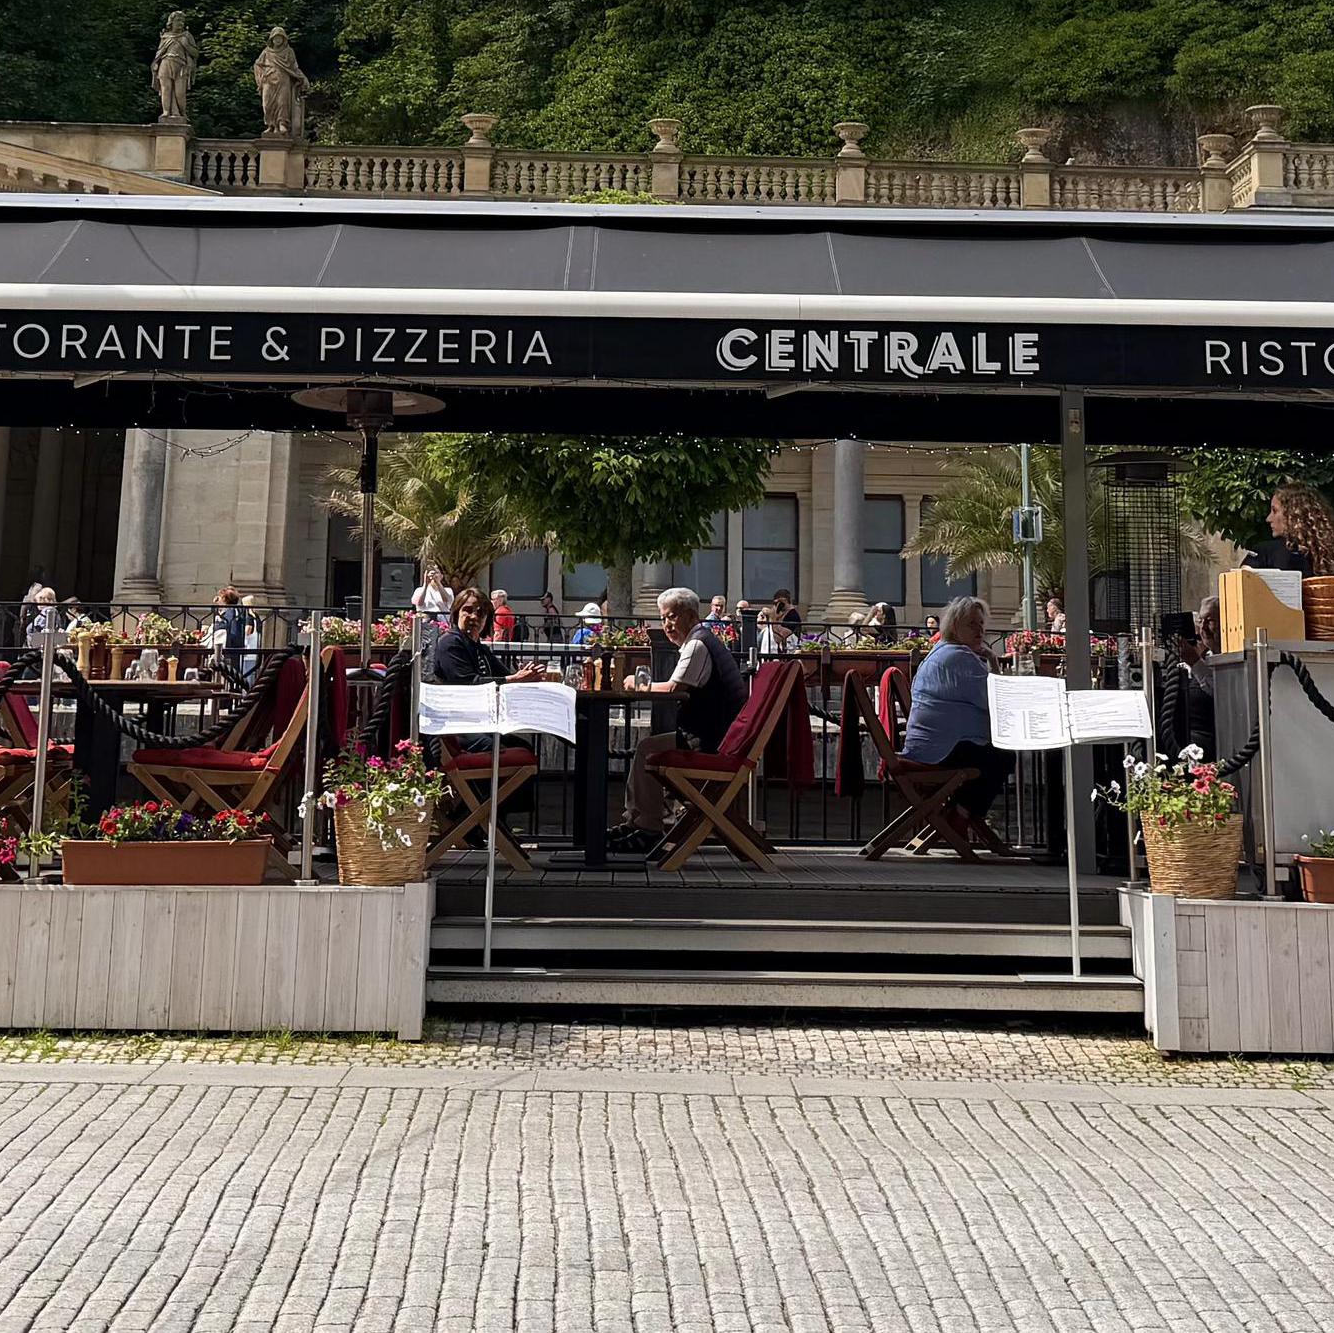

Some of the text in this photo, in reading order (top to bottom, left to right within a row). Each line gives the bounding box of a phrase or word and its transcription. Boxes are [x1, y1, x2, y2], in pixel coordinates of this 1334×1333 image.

[261, 326, 291, 361] &
[320, 327, 552, 365] PIZZERIA
[717, 328, 1040, 378] CENTRALE
